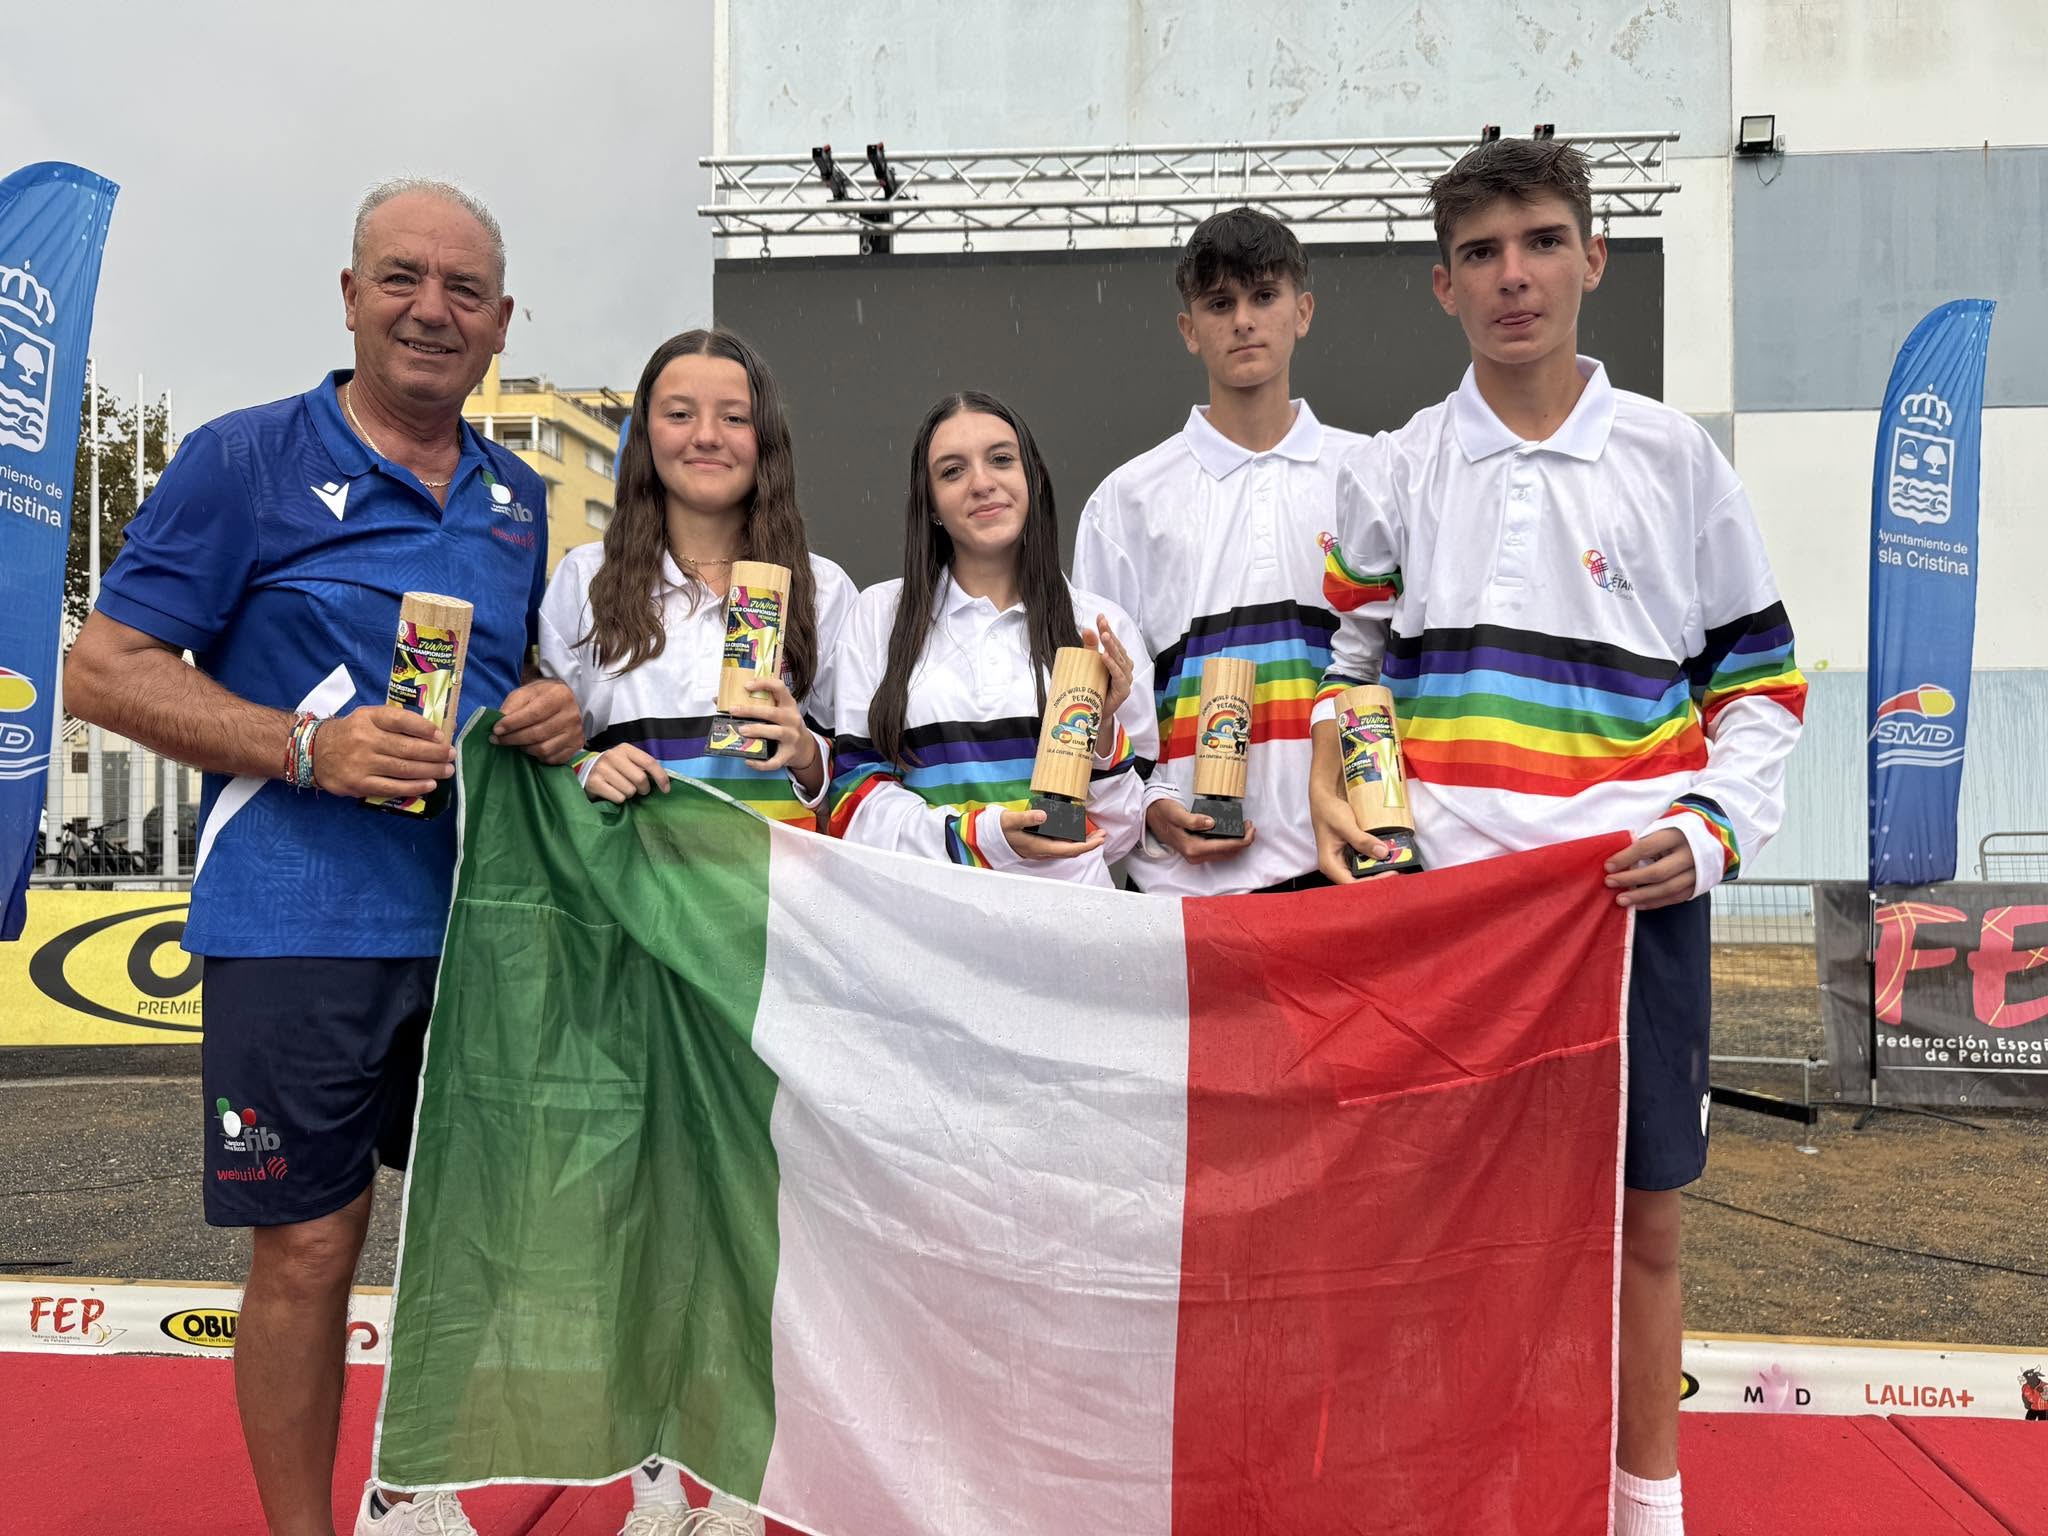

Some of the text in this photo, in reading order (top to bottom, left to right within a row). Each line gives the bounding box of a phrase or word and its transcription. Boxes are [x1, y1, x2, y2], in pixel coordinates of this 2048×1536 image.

[45, 482, 63, 499] de
[1878, 528, 1968, 554] Ayuntamiento de
[1878, 547, 1968, 575] sla Cristina
[1877, 721, 1955, 747] SMD
[137, 1000, 201, 1015] PREMIE
[1876, 1034, 1989, 1049] Federación
[1925, 1048, 2042, 1064] de Petanca
[243, 1126, 281, 1152] fib
[217, 1166, 267, 1182] webuild
[29, 1296, 105, 1335] FEP
[183, 1314, 238, 1338] OBU
[1865, 1384, 1974, 1408] LALIGA+
